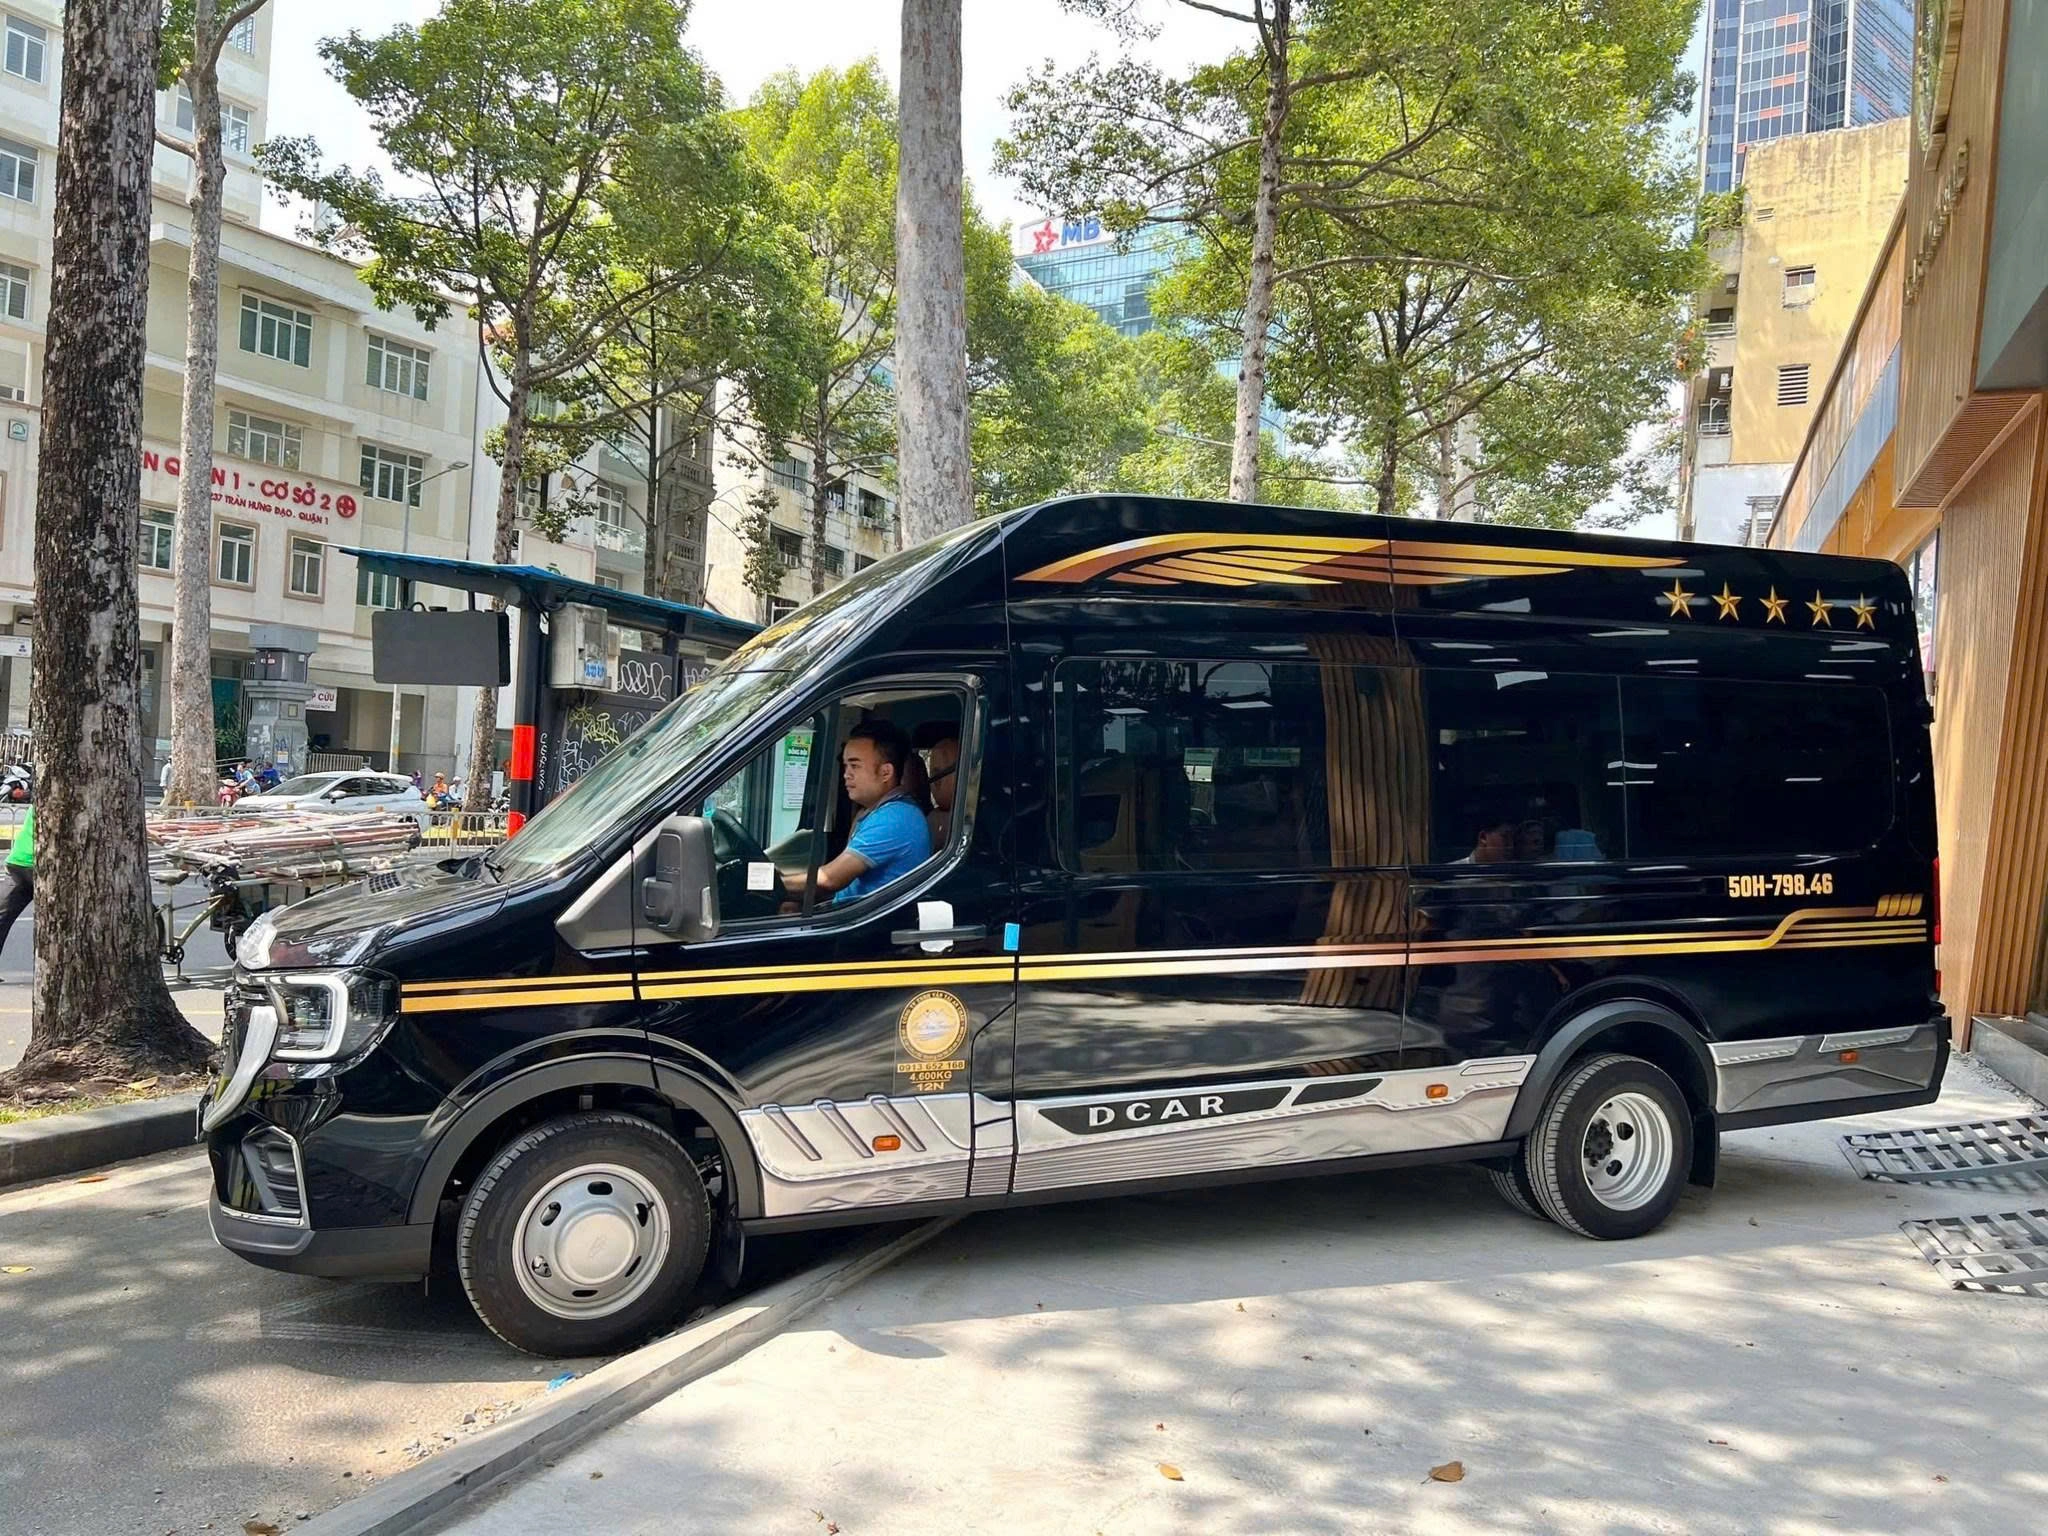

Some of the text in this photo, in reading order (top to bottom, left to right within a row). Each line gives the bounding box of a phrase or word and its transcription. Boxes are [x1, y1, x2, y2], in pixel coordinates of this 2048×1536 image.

[1061, 216, 1100, 246] MB
[233, 471, 240, 490] 1
[261, 480, 289, 500] CƠ
[292, 481, 317, 506] SỞ
[320, 494, 331, 510] 2
[325, 517, 329, 525] 1
[1728, 873, 1833, 897] 50H-798.46
[899, 1063, 923, 1071] 0913
[916, 1082, 944, 1091] 12N
[1088, 1096, 1225, 1127] DCAR
